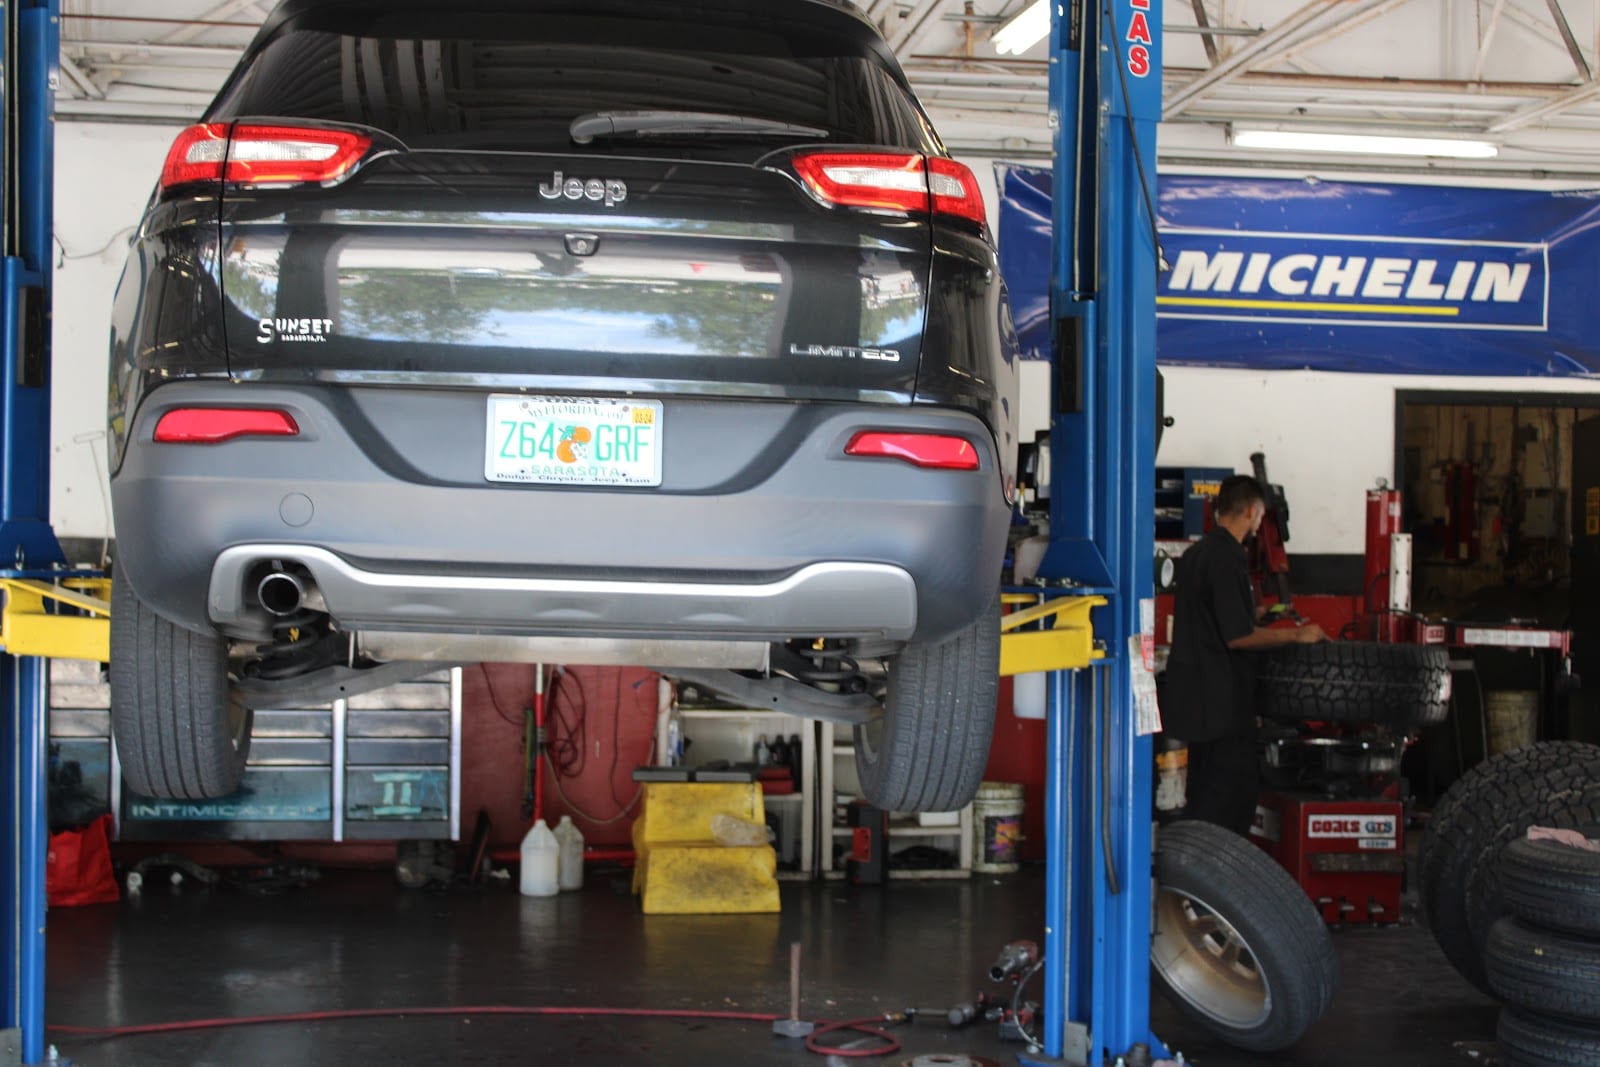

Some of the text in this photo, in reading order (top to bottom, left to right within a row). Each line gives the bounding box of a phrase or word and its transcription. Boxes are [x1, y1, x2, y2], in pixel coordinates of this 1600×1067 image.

[539, 170, 627, 207] Jeep
[1168, 250, 1531, 302] MICHELIN
[257, 318, 334, 343] SUNSET
[790, 343, 900, 361] LIMITED
[500, 421, 651, 463] Z64 GRF
[531, 465, 620, 477] SARASOTA
